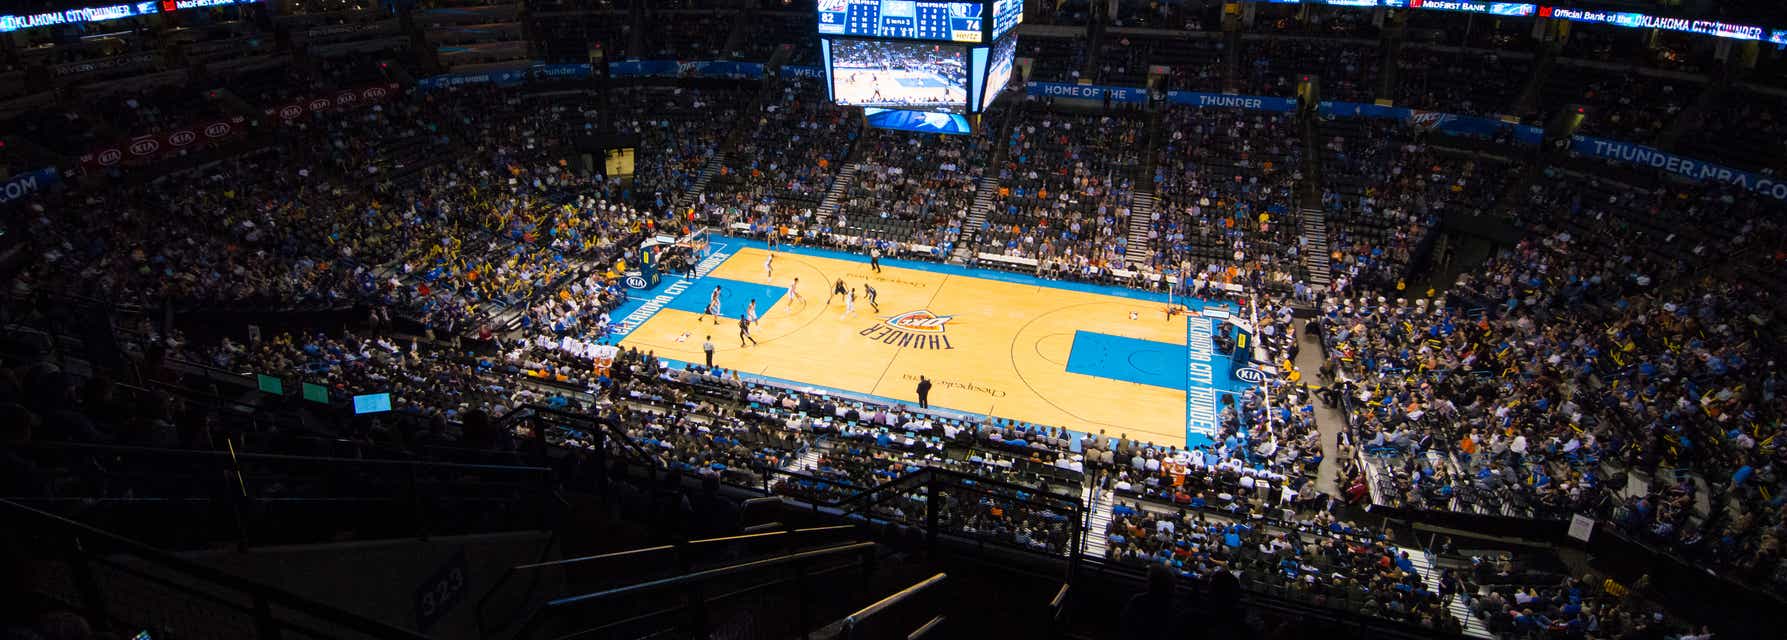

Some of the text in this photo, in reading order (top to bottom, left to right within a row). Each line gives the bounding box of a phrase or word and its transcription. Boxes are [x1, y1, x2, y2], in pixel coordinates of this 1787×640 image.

[1463, 3, 1486, 12] BANK
[7, 12, 66, 29] OKLAHOMA
[821, 12, 835, 23] 82
[966, 20, 980, 31] 74
[1554, 8, 1582, 19] Official
[1584, 11, 1606, 22] Bank
[1607, 14, 1616, 23] of
[1634, 15, 1690, 31] OKLAHOMA
[1692, 20, 1714, 34] CITY
[1714, 21, 1763, 40] THUNDER
[1044, 84, 1080, 97] HOME
[1081, 87, 1101, 98] OF
[1200, 94, 1263, 110] THUNDER
[664, 279, 694, 295] CITY
[859, 323, 954, 350] THUNDER
[1190, 317, 1215, 438] OKLAHOMA CITY THUNDER
